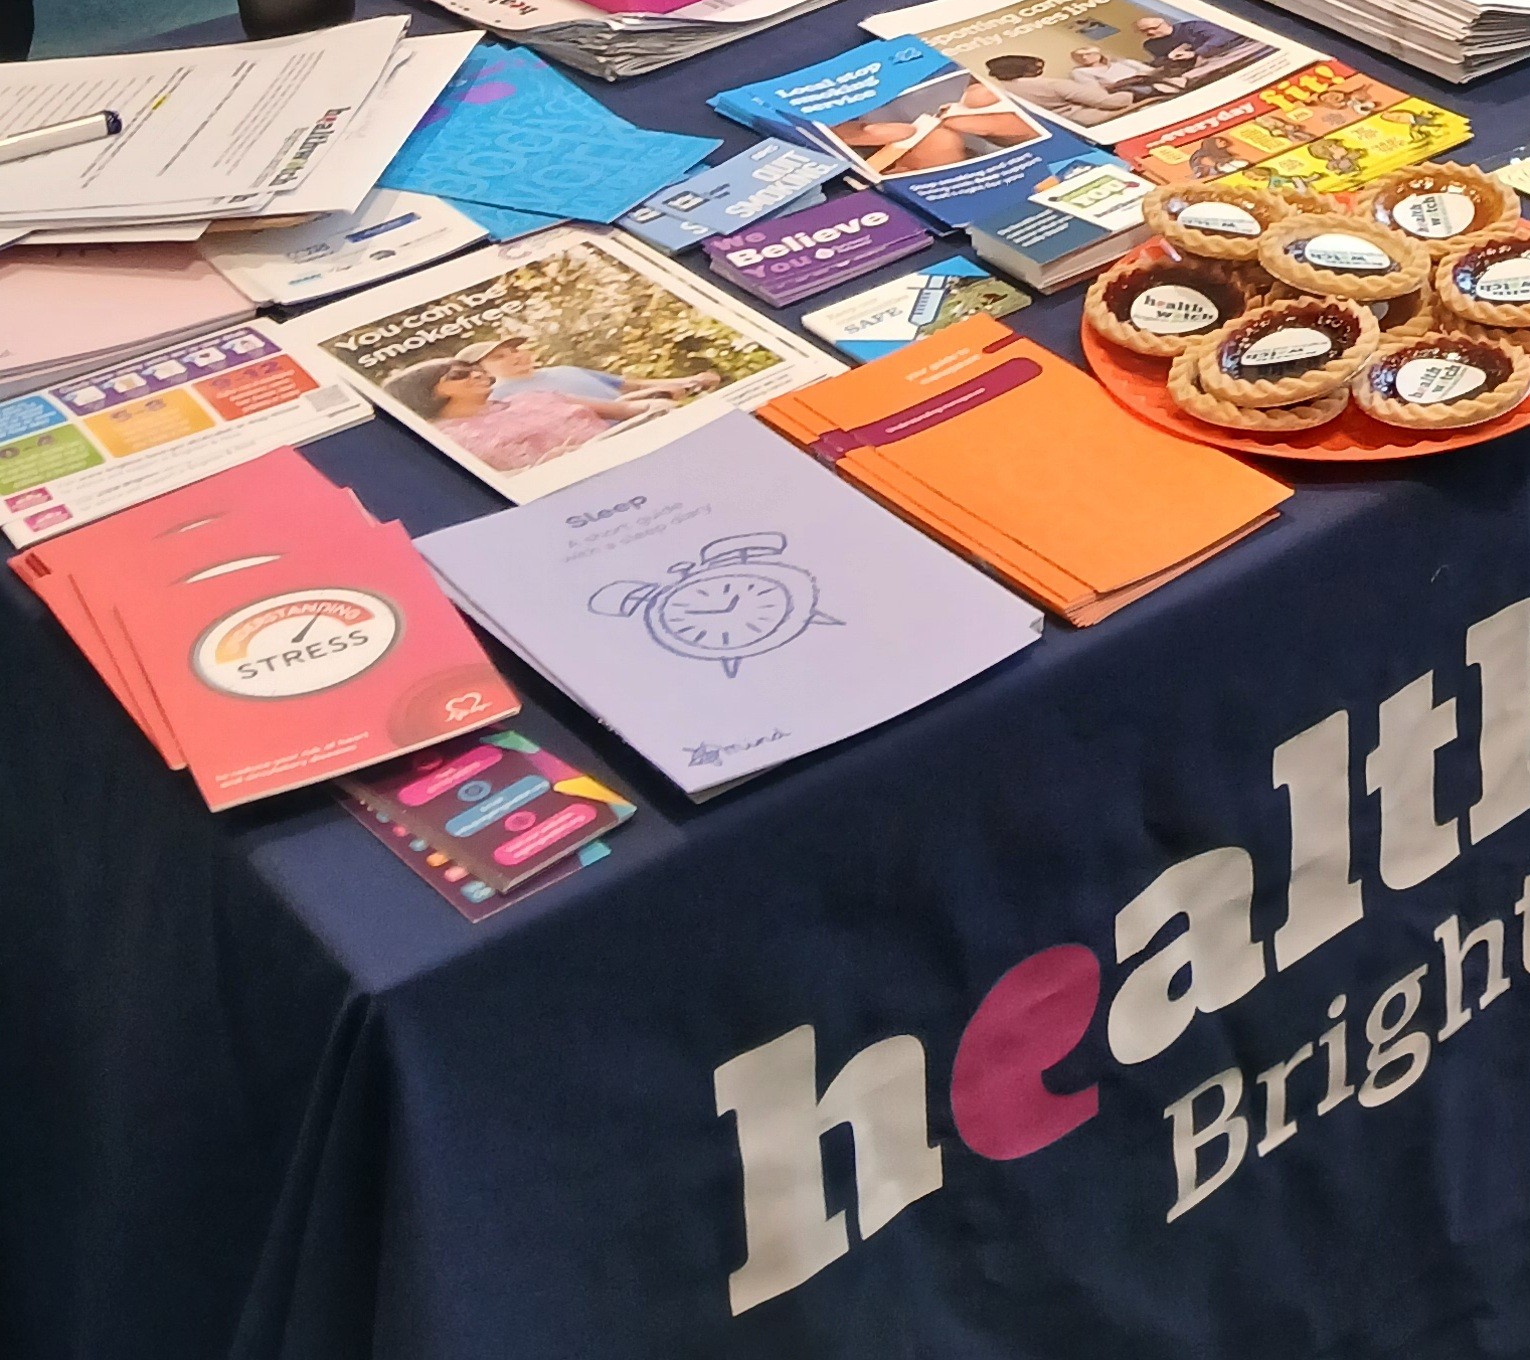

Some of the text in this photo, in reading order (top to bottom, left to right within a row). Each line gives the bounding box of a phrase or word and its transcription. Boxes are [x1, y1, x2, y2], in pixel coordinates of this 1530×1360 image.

[922, 13, 1014, 47] Spotting
[1001, 13, 1065, 41] saves
[774, 62, 882, 99] Local stop
[1258, 64, 1346, 113] fit!
[800, 88, 877, 115] service
[751, 149, 813, 181] QUIT
[710, 231, 767, 252] We
[726, 211, 890, 269] Believe
[743, 255, 813, 279] You
[333, 281, 509, 354] You can be
[1143, 294, 1205, 314] health
[1156, 308, 1215, 322] watch
[357, 295, 525, 370] smokefree
[843, 305, 905, 336] SAFE
[1407, 366, 1442, 399] health
[1432, 363, 1462, 394] watch
[565, 495, 648, 529] Sleep
[236, 629, 370, 681] STRESS
